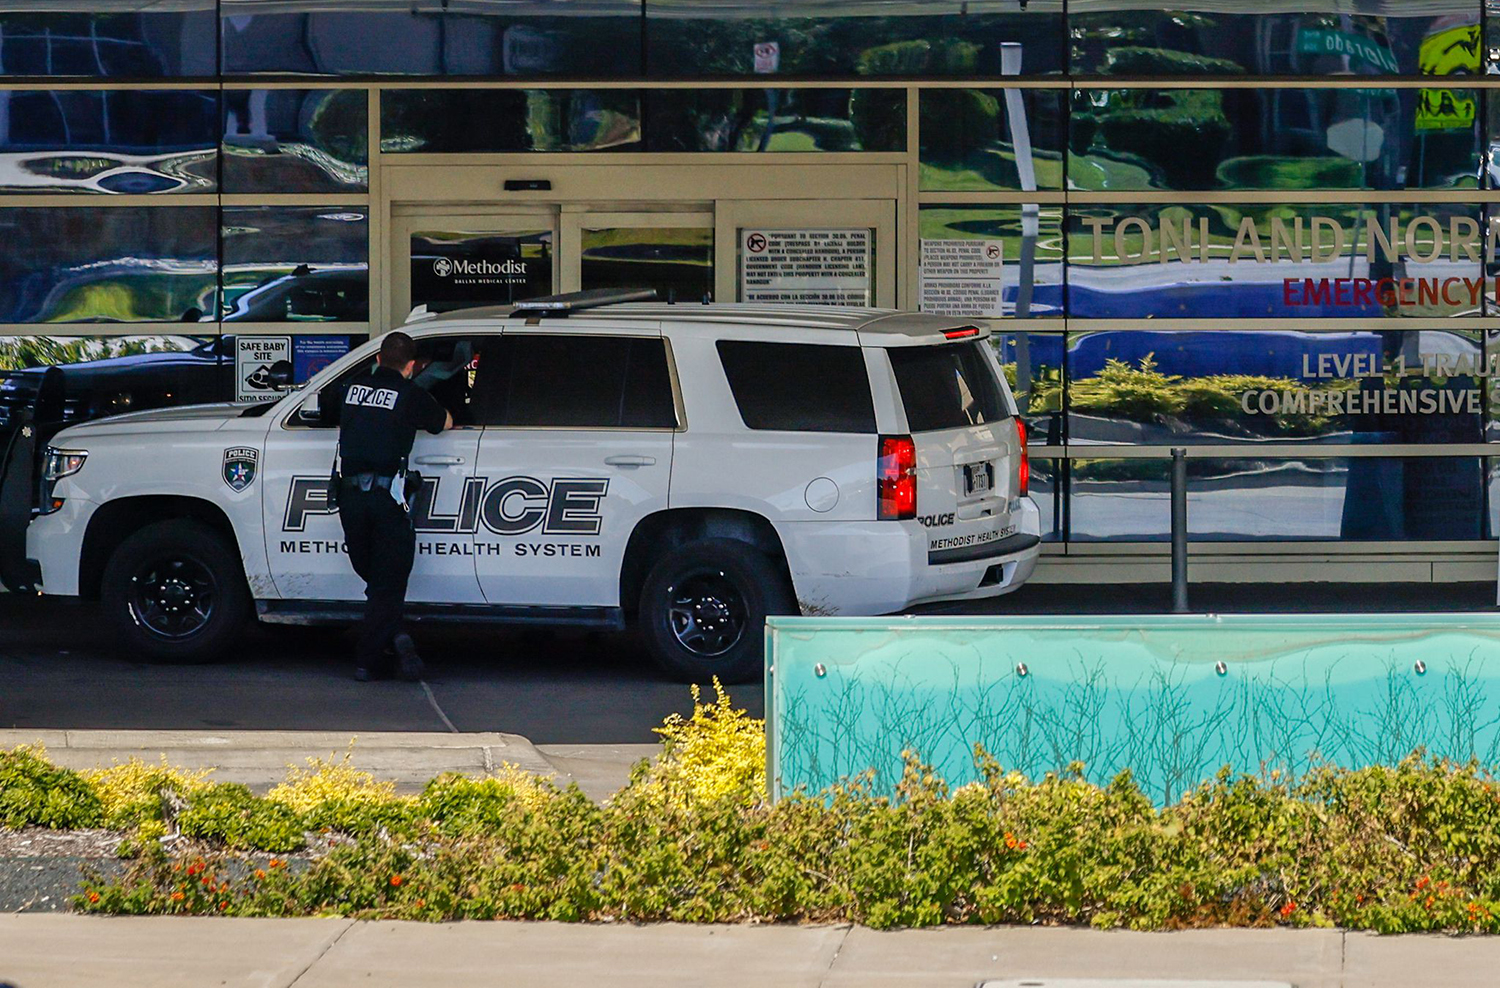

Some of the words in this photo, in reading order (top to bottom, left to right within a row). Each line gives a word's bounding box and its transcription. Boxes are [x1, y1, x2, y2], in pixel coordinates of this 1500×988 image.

[1082, 216, 1209, 264] TONI
[1227, 216, 1344, 264] AND
[454, 260, 527, 274] Methodist
[1283, 277, 1484, 306] EMERGENCY
[241, 343, 261, 351] SAFE
[254, 352, 272, 360] SITE
[1303, 353, 1408, 378] LEVEL-1
[349, 387, 393, 406] POLICE
[1241, 389, 1481, 415] COMPREHENSIVE
[229, 450, 255, 458] POLICE
[282, 475, 610, 536] PLICE
[917, 513, 954, 527] POLICE
[280, 541, 350, 553] METHO
[419, 543, 500, 556] HEALTH
[514, 543, 600, 557] SYSTEM
[931, 535, 975, 549] METHODIST
[977, 531, 998, 541] HEALTH
